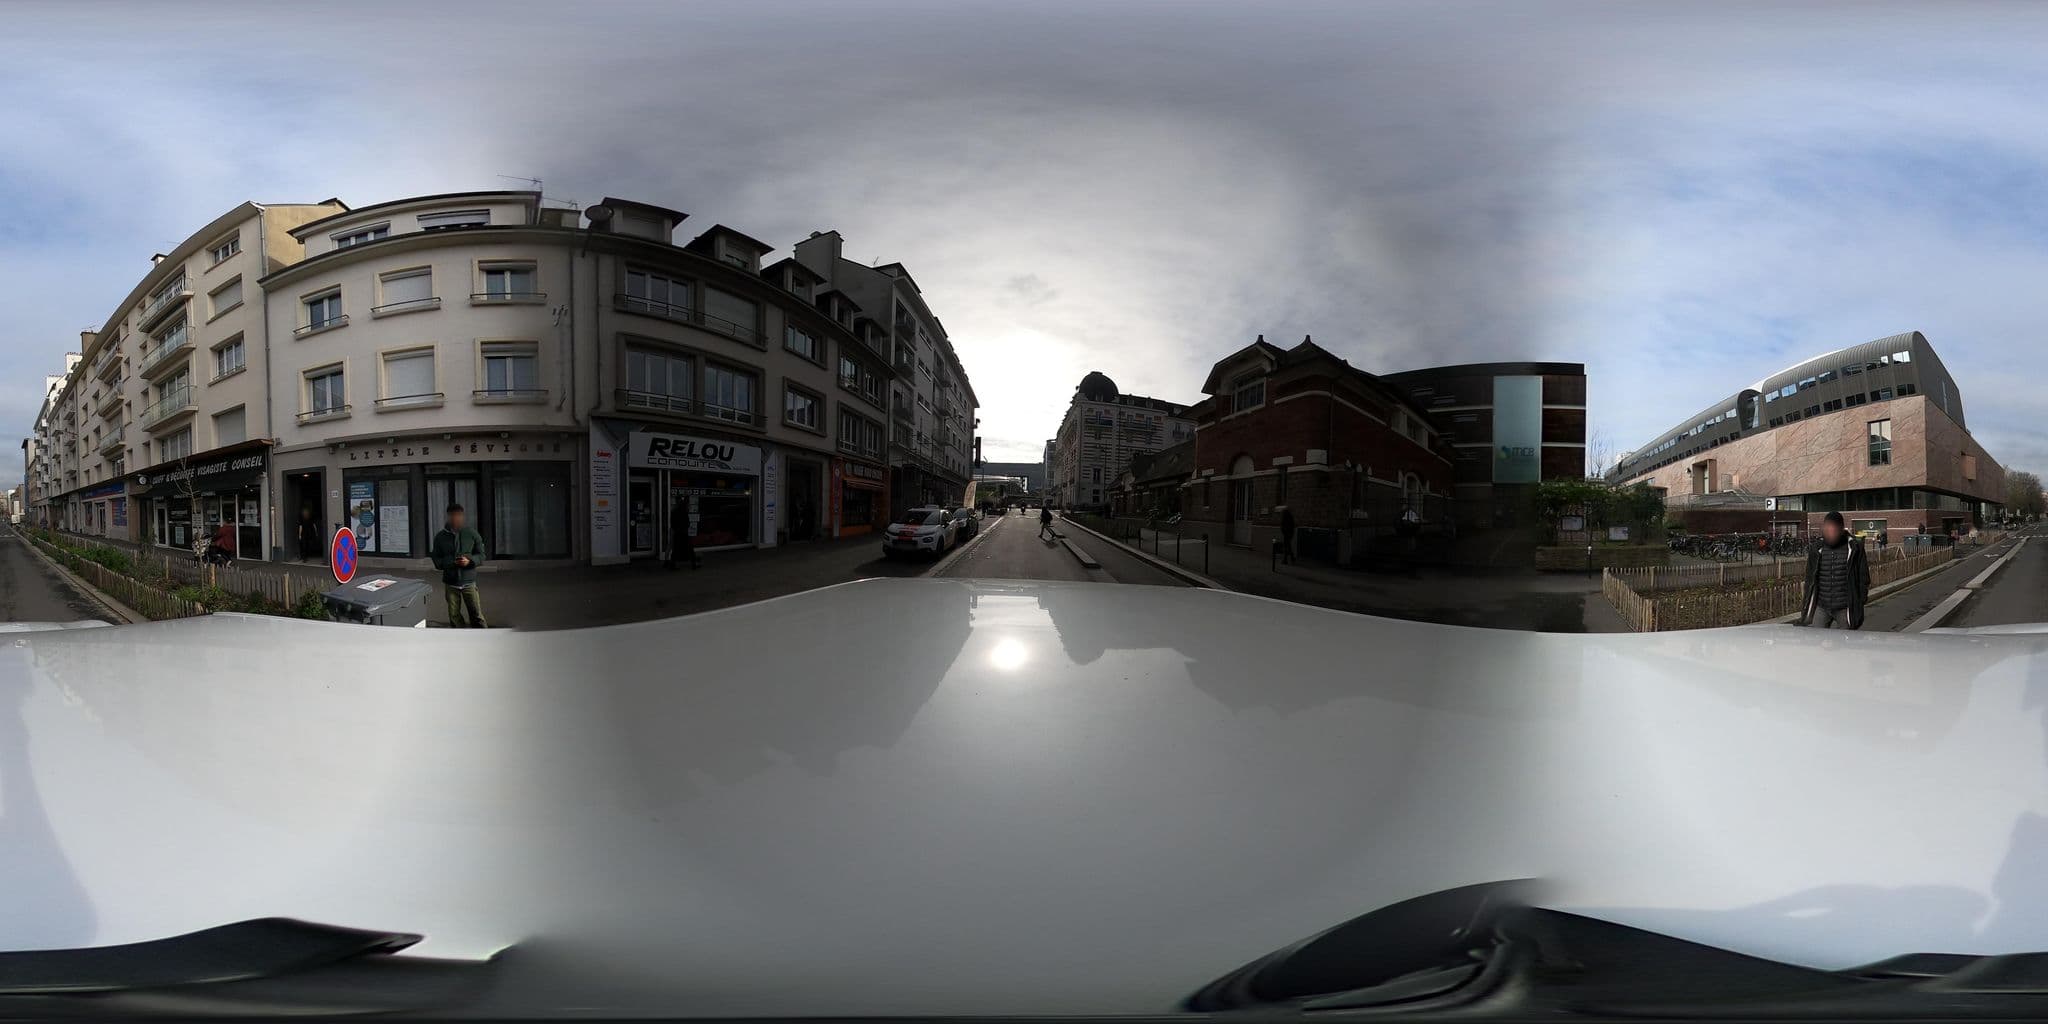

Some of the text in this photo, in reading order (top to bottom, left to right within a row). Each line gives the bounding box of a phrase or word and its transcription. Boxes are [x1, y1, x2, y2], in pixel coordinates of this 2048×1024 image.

[350, 447, 430, 460] LITTLE
[648, 437, 735, 461] RELOU
[197, 462, 227, 476] VISAGISTE
[231, 455, 263, 471] CONSEIL
[648, 457, 716, 469] CONDUITE
[1766, 499, 1773, 509] P
